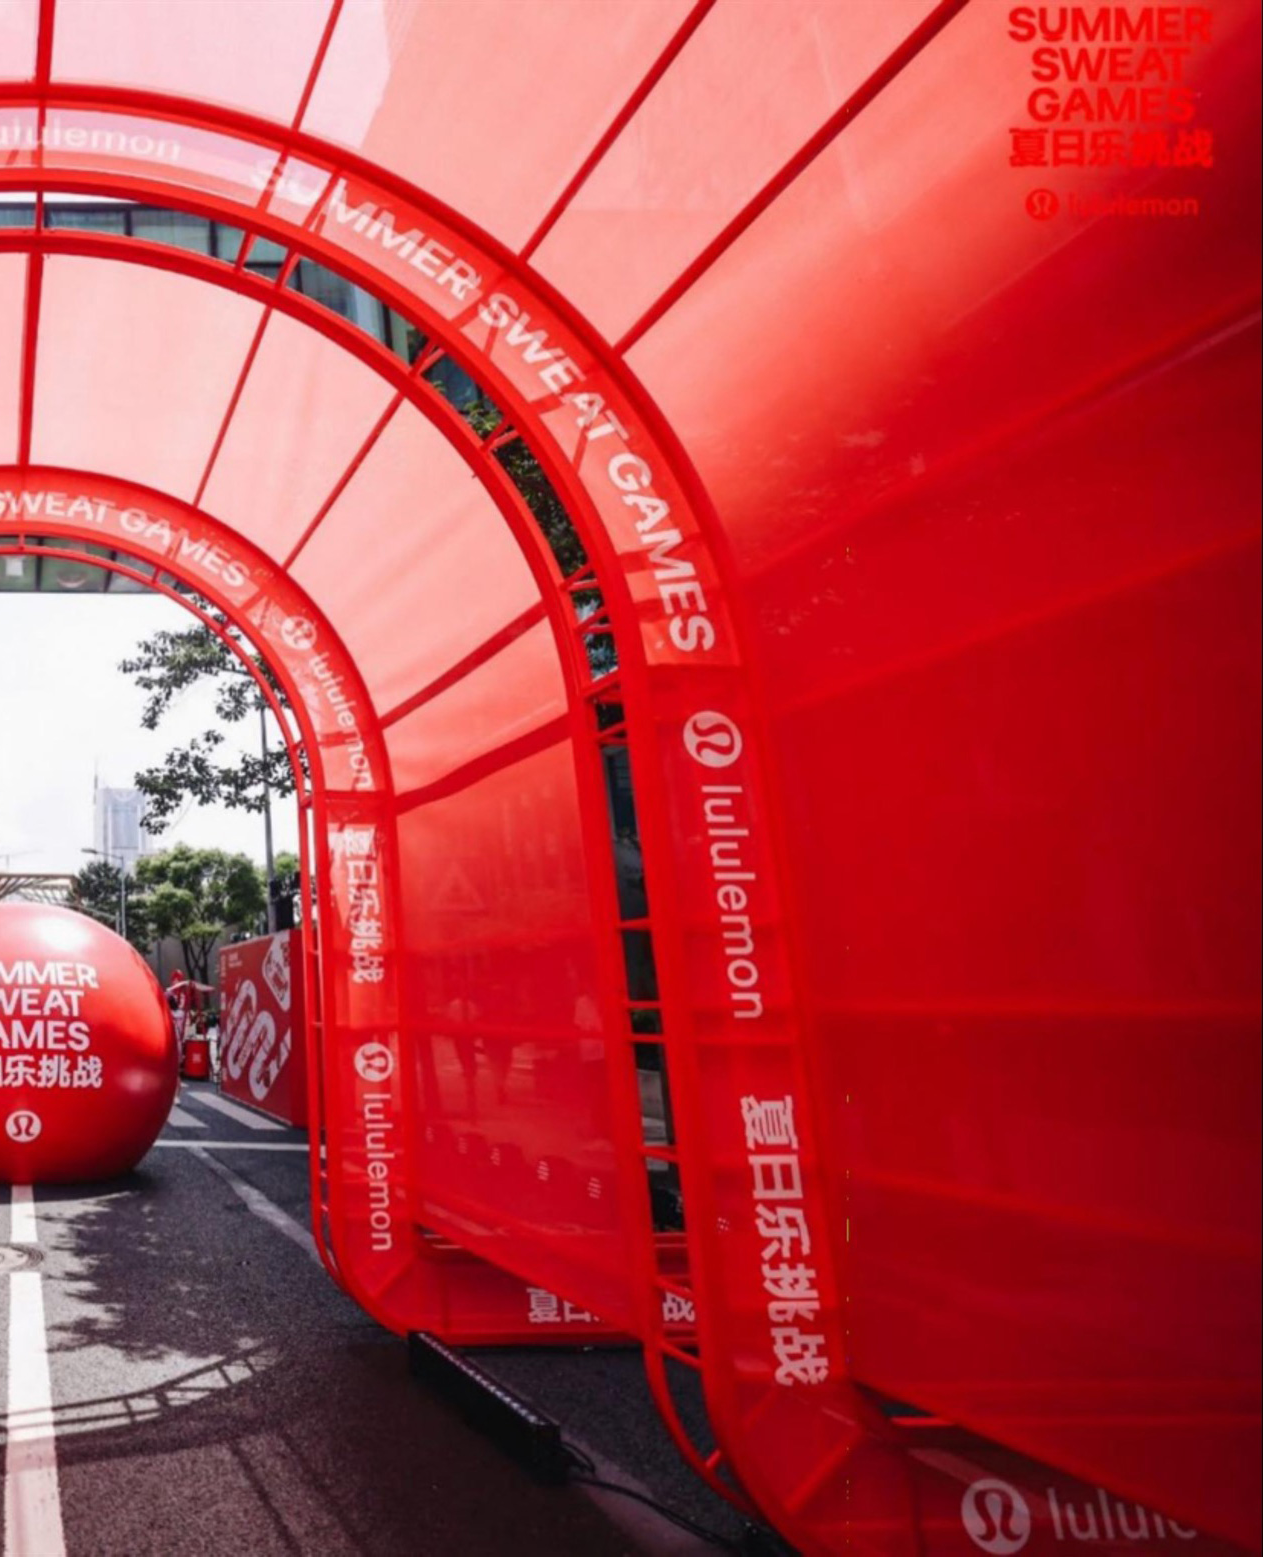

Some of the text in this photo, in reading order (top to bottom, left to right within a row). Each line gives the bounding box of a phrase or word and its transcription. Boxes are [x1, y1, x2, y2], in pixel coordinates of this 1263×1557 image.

[250, 160, 715, 652] SUMMER SWEAT GAMES
[119, 508, 249, 587] GAMES
[701, 785, 763, 1018] lululemon
[363, 1093, 394, 1252] lululemon
[740, 1095, 829, 1386] 夏日乐挑战
